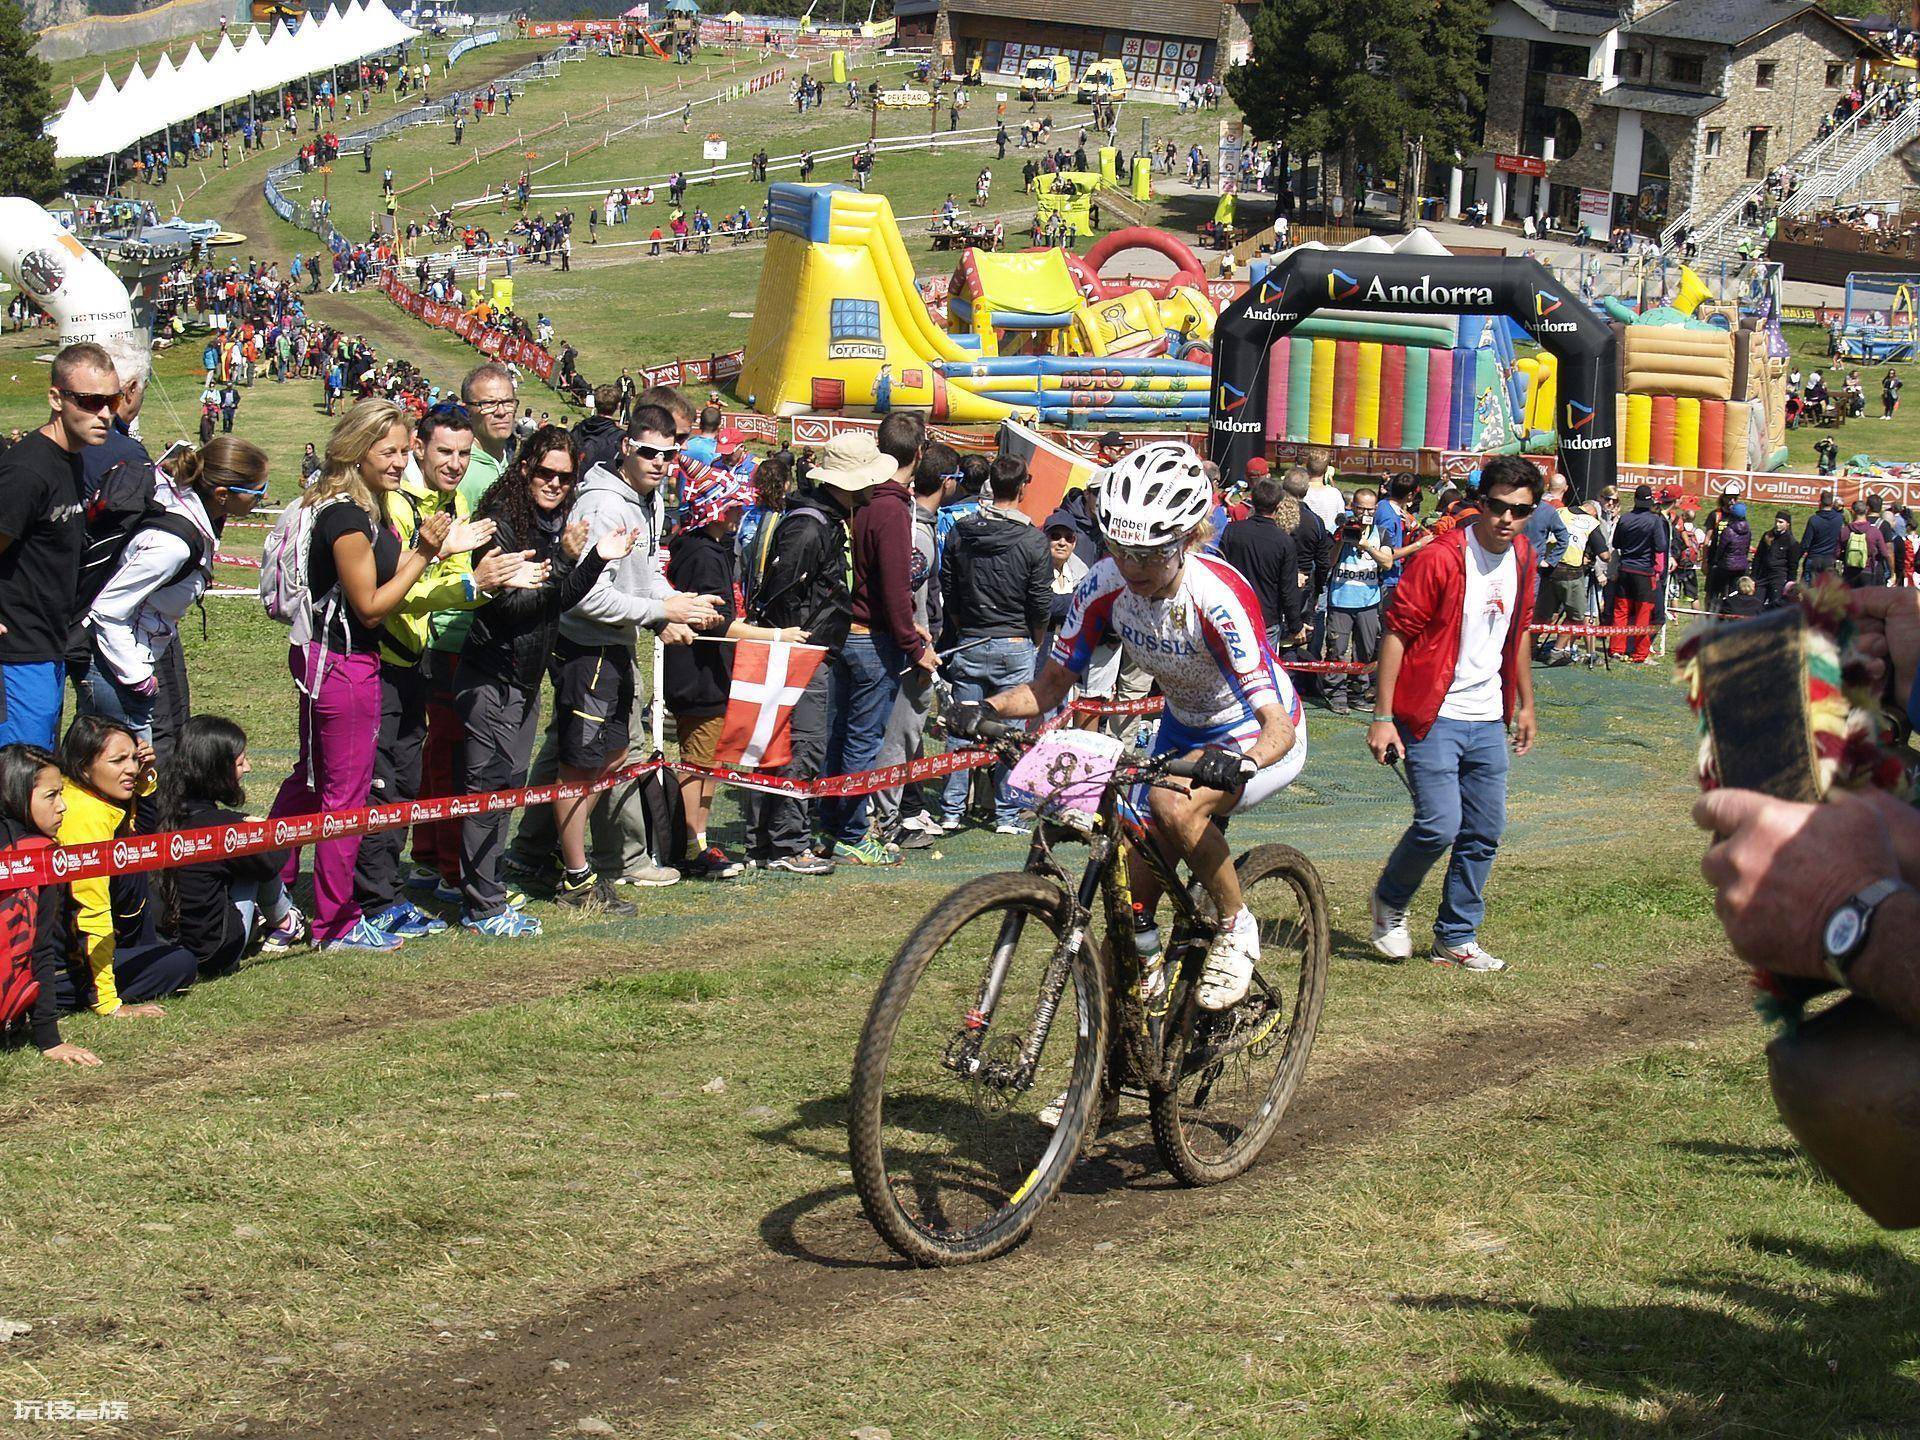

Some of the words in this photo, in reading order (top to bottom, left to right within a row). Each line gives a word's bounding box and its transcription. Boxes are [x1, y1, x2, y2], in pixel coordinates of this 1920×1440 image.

[1362, 275, 1493, 305] Andorra
[90, 311, 127, 321] TISSOT
[1243, 306, 1297, 321] Andorra
[1524, 319, 1577, 332] Andorra
[1061, 368, 1124, 390] MOTO
[1072, 390, 1114, 407] GP
[1213, 416, 1261, 433] ndorra
[1120, 621, 1197, 655] RUSSIA
[1210, 605, 1246, 659] ITERA
[1047, 751, 1078, 789] 8
